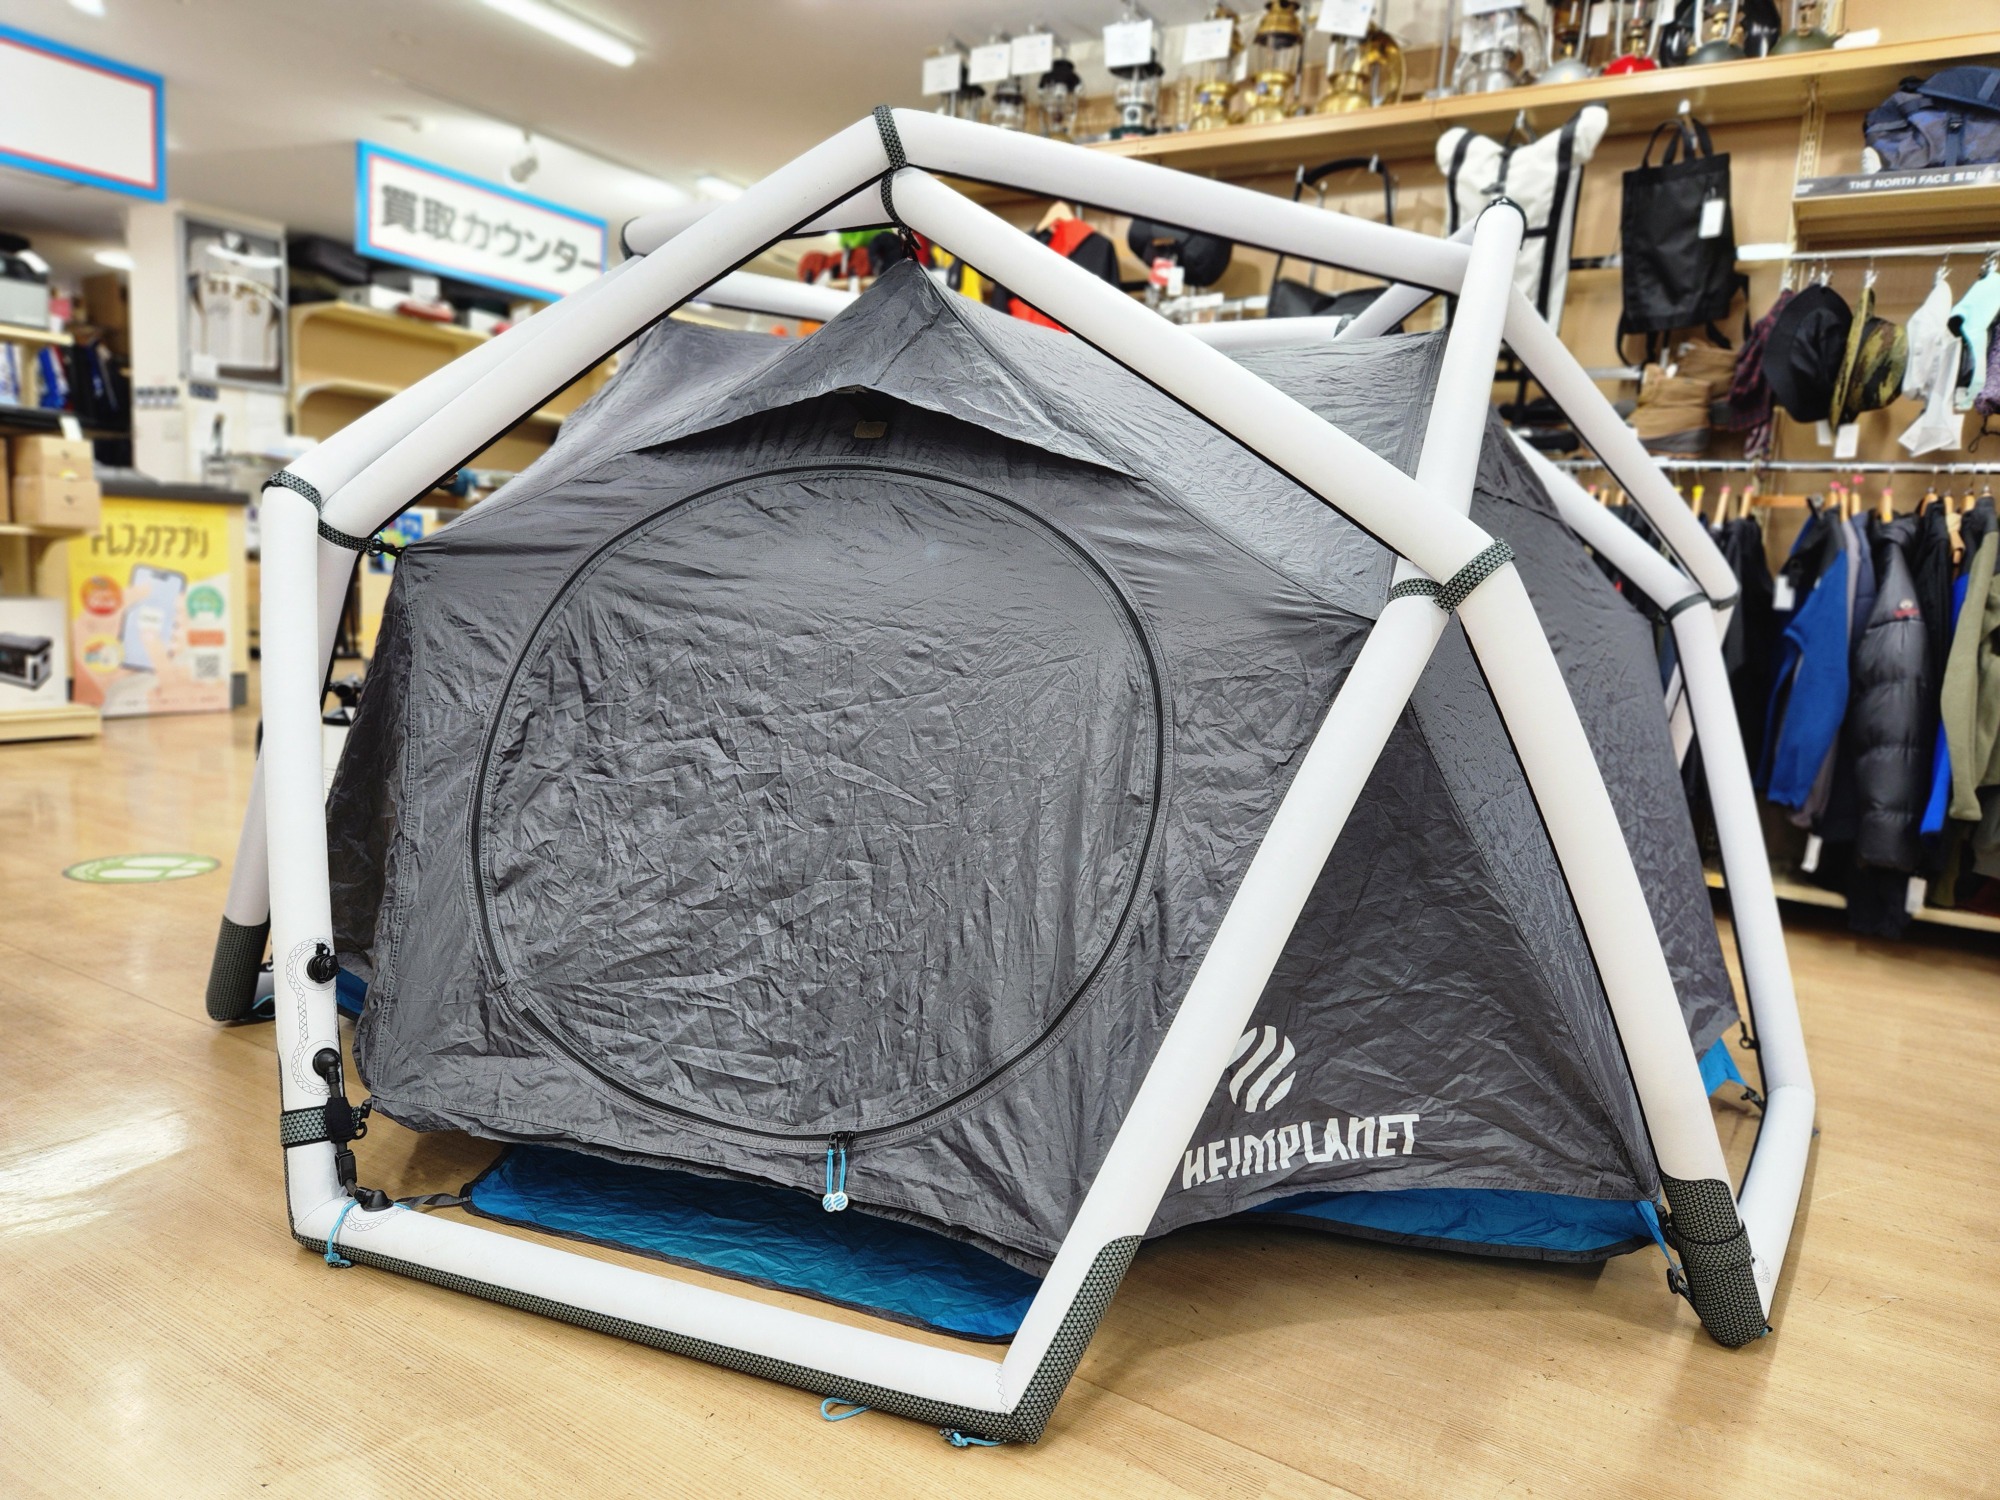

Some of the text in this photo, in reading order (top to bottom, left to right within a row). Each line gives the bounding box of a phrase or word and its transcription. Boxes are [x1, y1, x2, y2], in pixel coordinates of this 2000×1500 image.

[1849, 180, 1871, 190] THE
[1874, 177, 1916, 188] NORTH
[1918, 174, 1950, 184] FACE
[381, 184, 601, 272] 買取カウンター
[1182, 1113, 1420, 1190] HEIMPLANET
